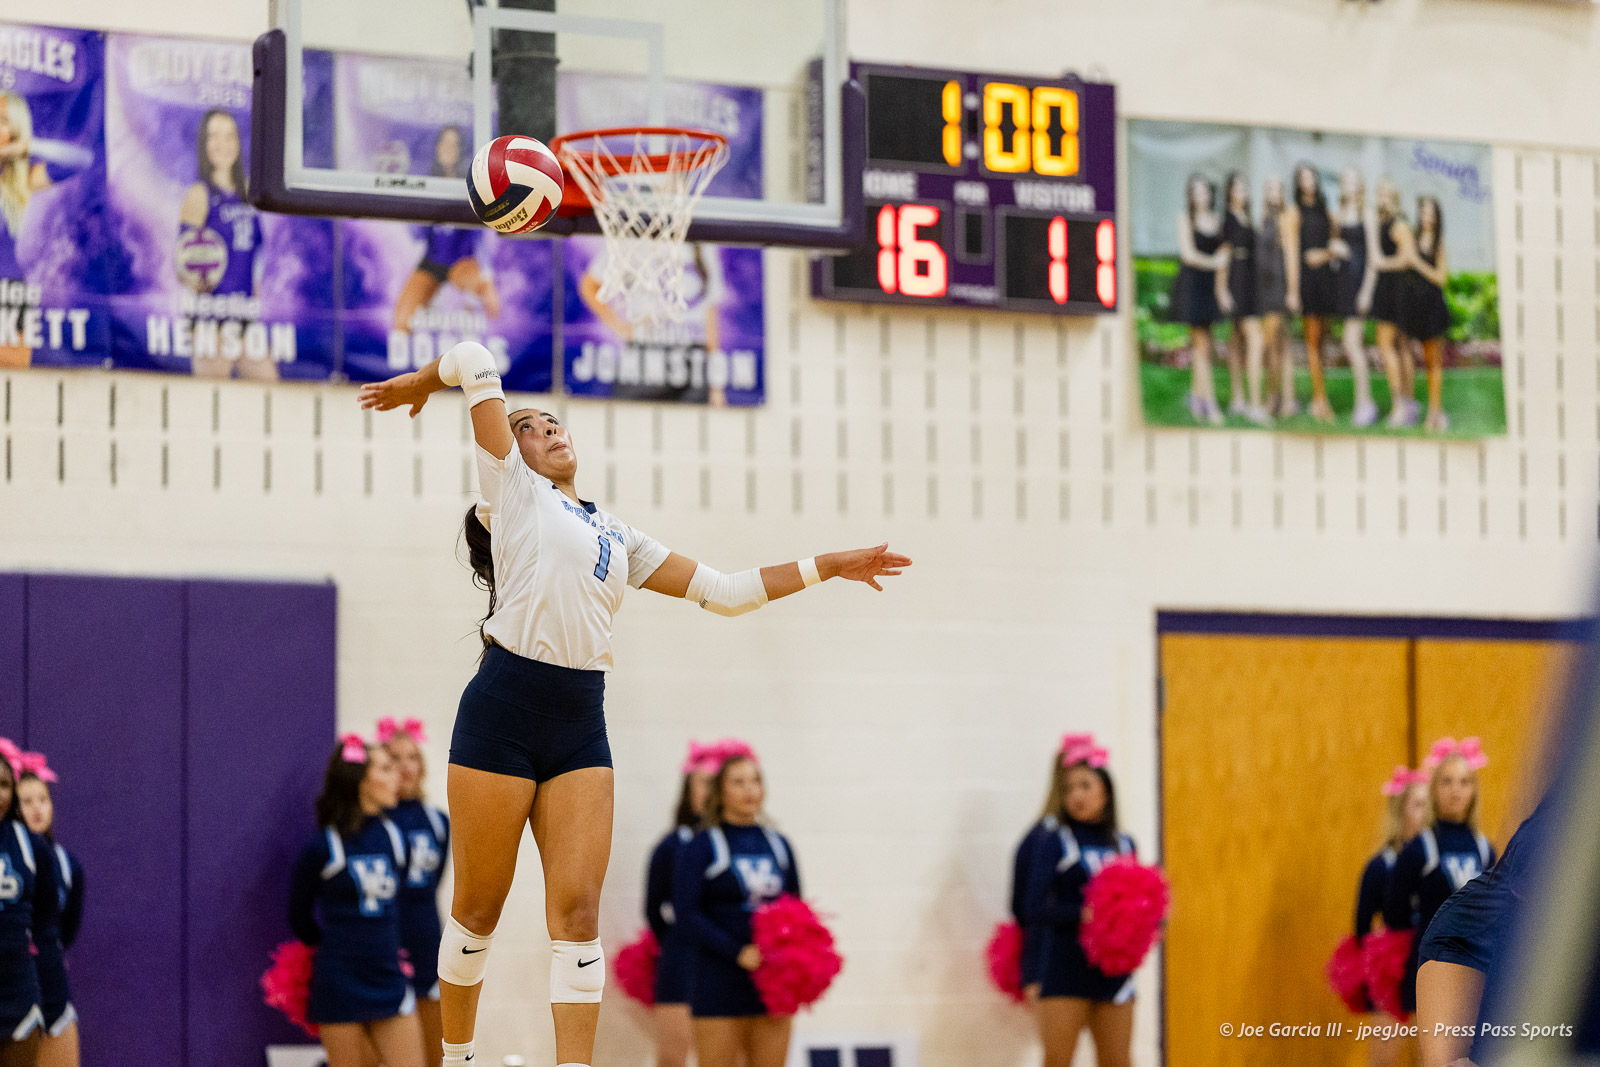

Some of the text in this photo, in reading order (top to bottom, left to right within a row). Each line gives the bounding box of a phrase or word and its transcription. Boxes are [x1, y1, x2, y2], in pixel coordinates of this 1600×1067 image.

[942, 80, 1079, 176] 1:00
[494, 207, 529, 231] Baden
[1013, 180, 1096, 213] VISITOR
[877, 204, 948, 297] 16
[1048, 216, 1116, 307] 11
[146, 314, 298, 363] HENSON
[386, 330, 511, 377] DOS
[572, 341, 757, 391] JOHNSTON
[593, 534, 611, 582] 1
